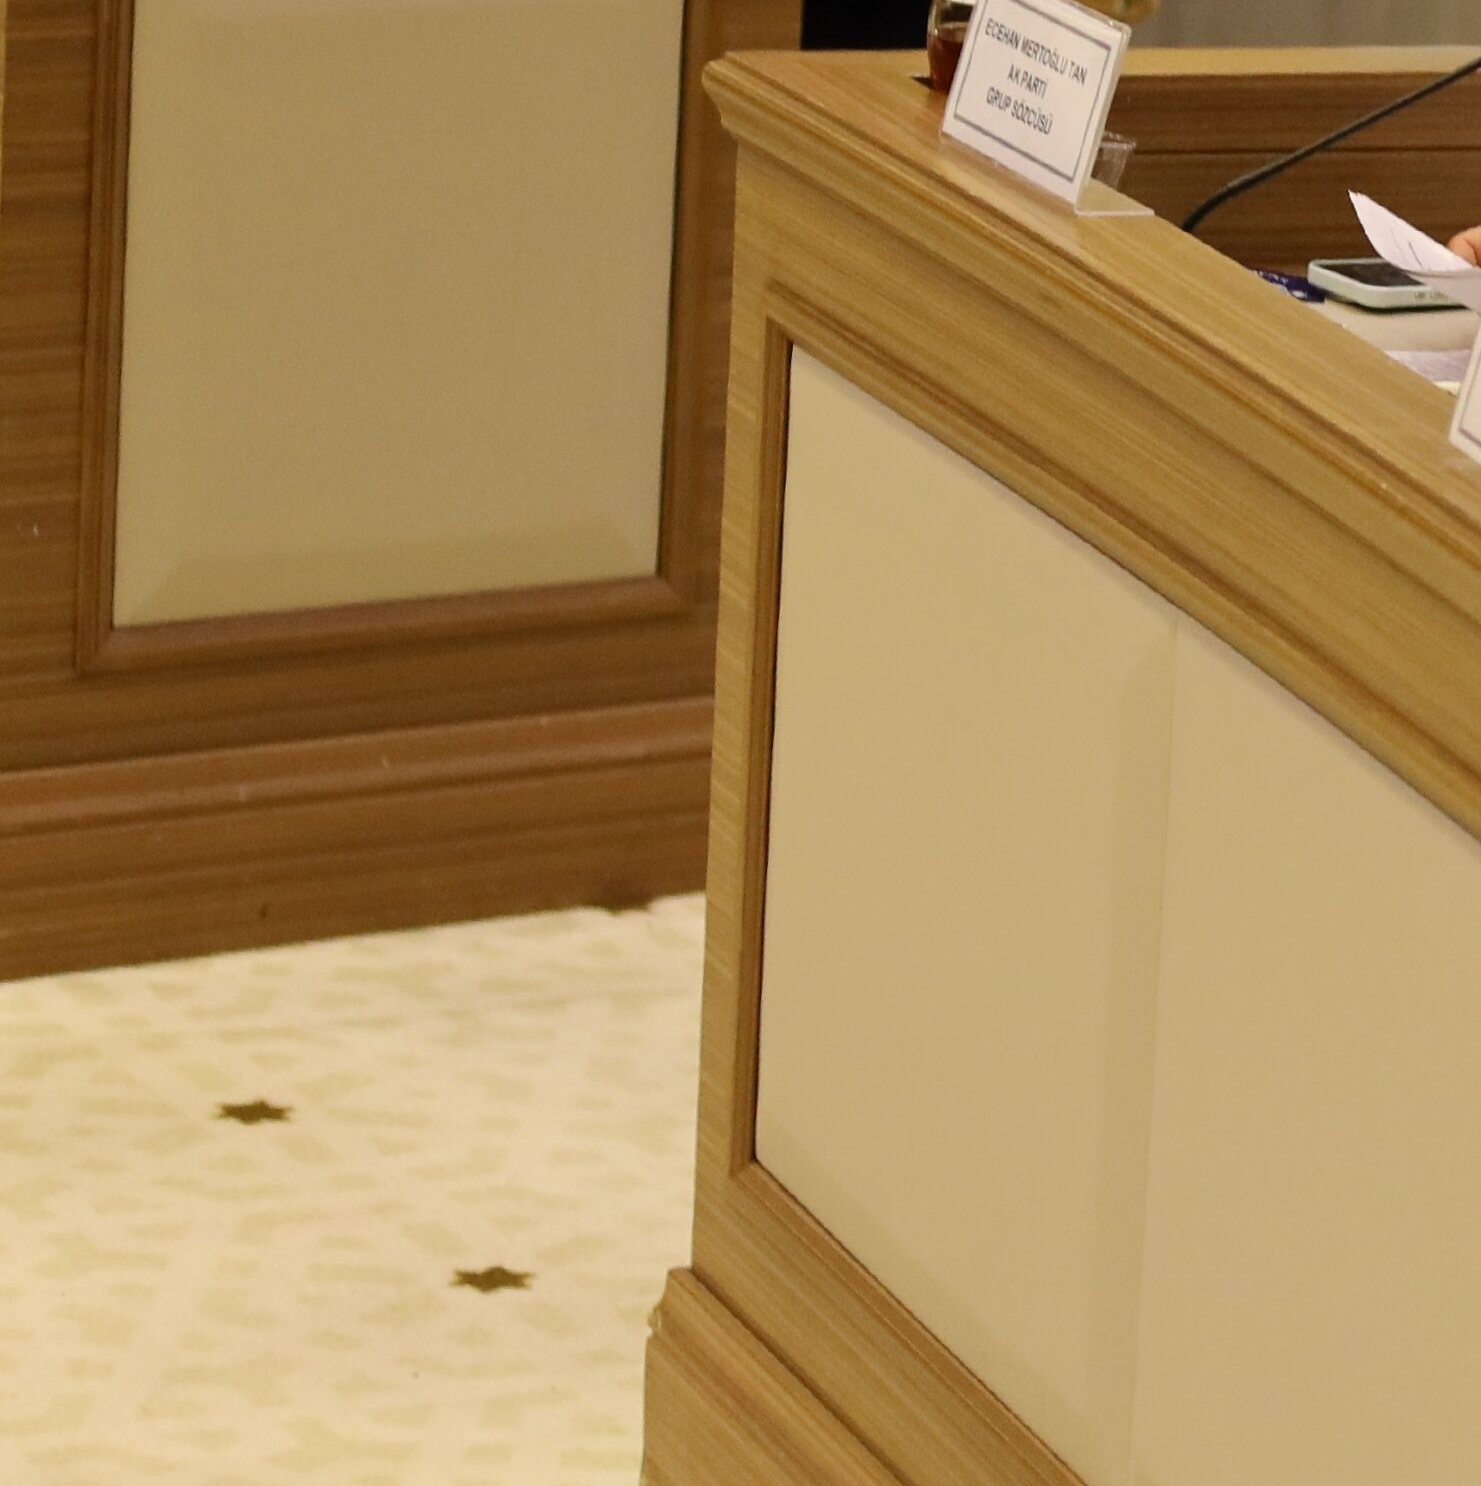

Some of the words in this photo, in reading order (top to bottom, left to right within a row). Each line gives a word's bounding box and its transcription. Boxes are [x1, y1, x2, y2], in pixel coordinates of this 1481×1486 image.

[984, 17, 1021, 51] ECEHAN
[1021, 36, 1069, 76] MERTOĞLU
[1068, 60, 1089, 86] TAN
[1007, 63, 1021, 85] AK
[1020, 70, 1048, 99] PARTİ
[986, 86, 1012, 113] GRUP
[1010, 98, 1054, 135] SÖZCÜSÜ
